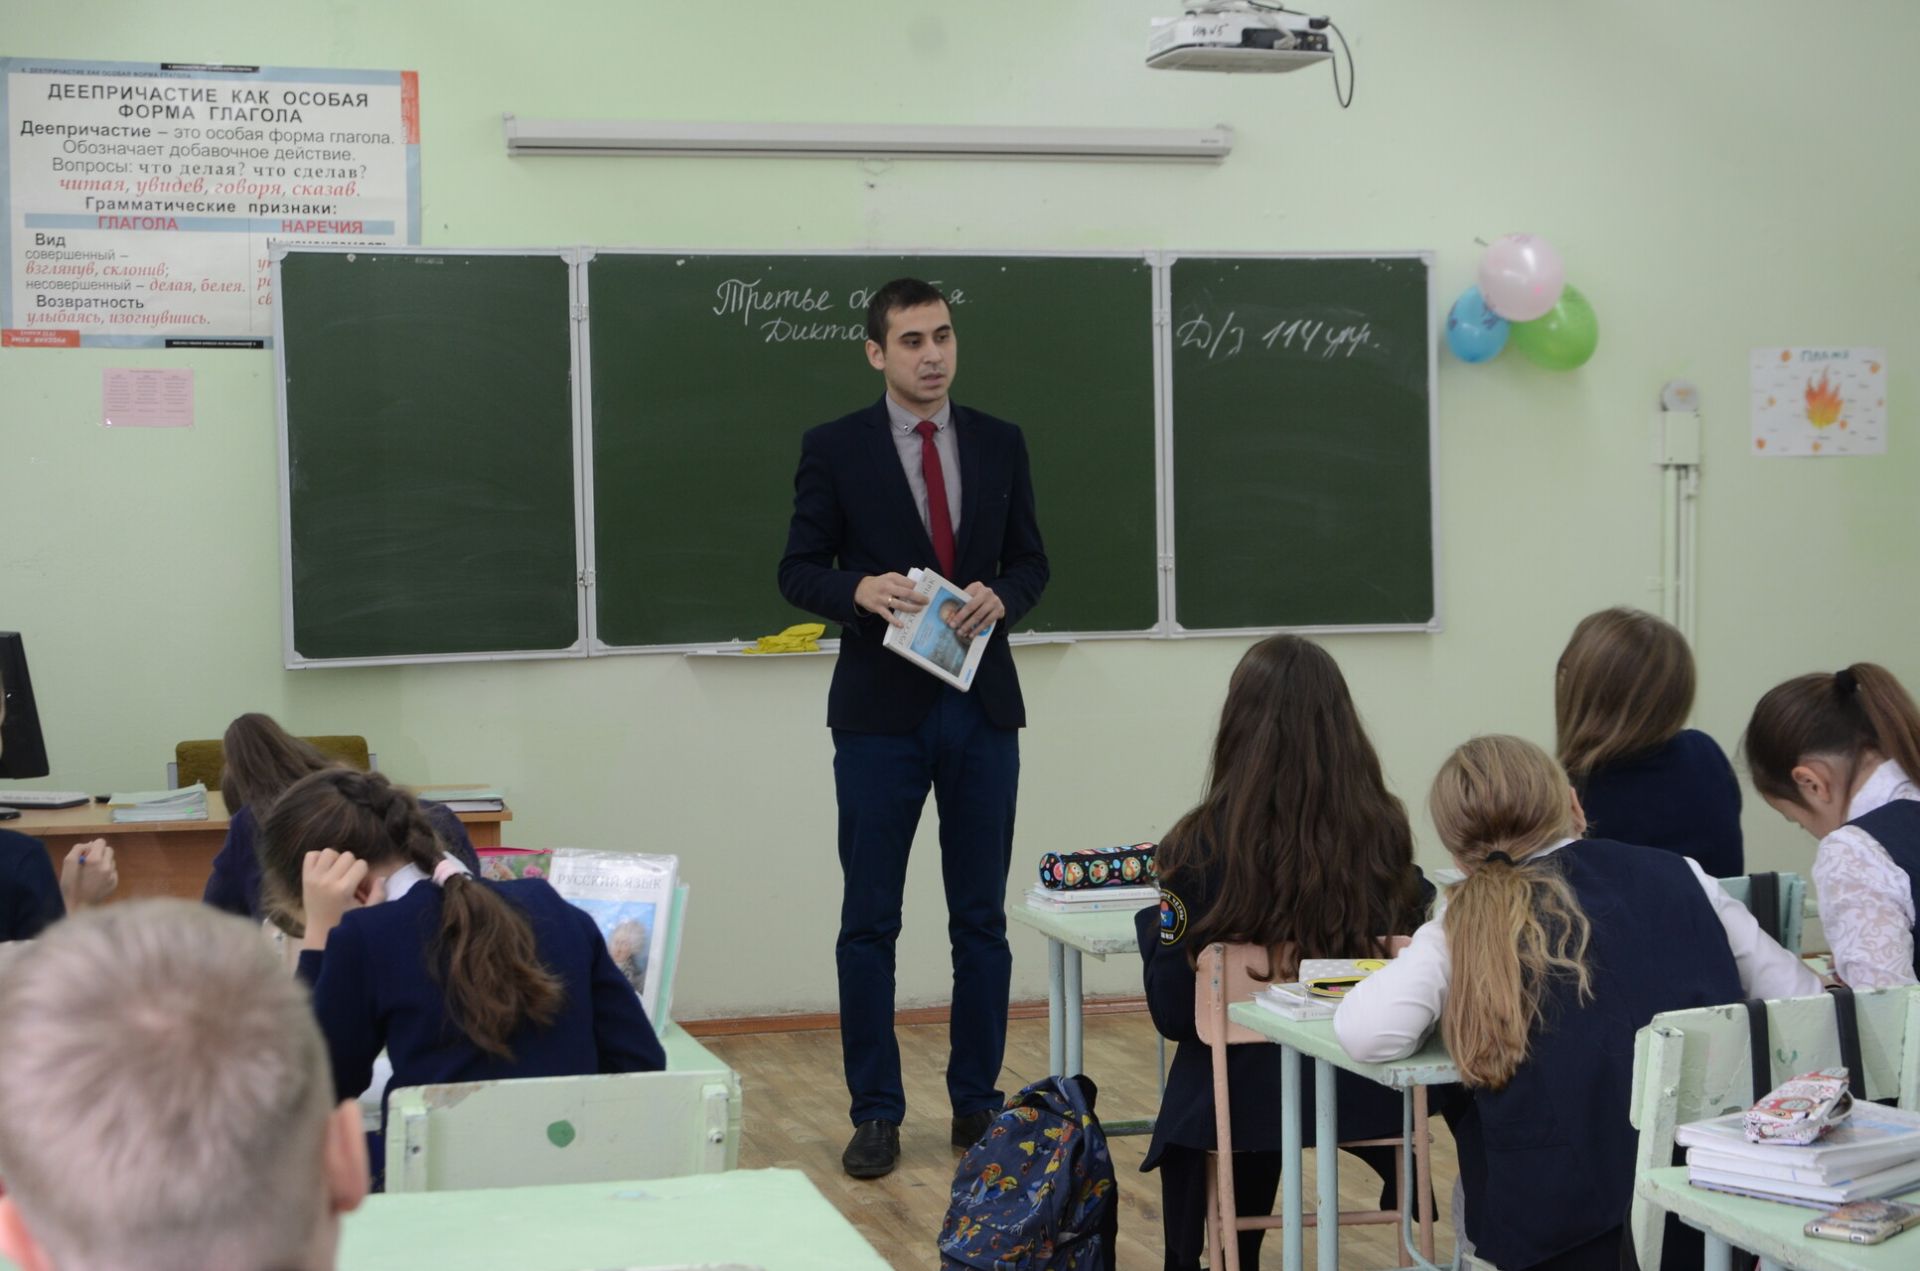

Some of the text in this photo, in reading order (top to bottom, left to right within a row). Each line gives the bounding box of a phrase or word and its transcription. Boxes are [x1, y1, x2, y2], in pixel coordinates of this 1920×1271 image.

[48, 83, 369, 108] ДЕЕПРИЧАСТИЕ КАК ОСОБАЯ
[119, 104, 303, 124] ФОРМА ГЛАГОЛА
[20, 121, 151, 139] Деепричастие
[174, 127, 202, 141] это
[206, 127, 264, 142] особая
[269, 129, 322, 145] форма
[329, 131, 394, 145] глагола.
[63, 140, 355, 162] Обозначает добавочное действие.
[52, 157, 366, 180] Вопросы: что делая? что сделав?
[59, 176, 361, 200] читая, увидев, говоря, сказав.
[86, 196, 337, 215] Грамматические признаки:
[97, 216, 178, 231] ГЛАГОЛА
[281, 219, 364, 234] НАРЕЧИЯ
[35, 233, 66, 247] Вид
[26, 248, 115, 262] совершенный
[26, 262, 169, 278] взглянув, склонив;
[26, 279, 132, 291] несовершенный
[149, 279, 197, 293] делая,
[201, 279, 247, 293] белея.
[36, 295, 144, 310] Возвратность
[713, 278, 834, 326] Третье
[26, 310, 211, 327] улыбаясь, изогнувшись.
[1262, 320, 1323, 351] 114
